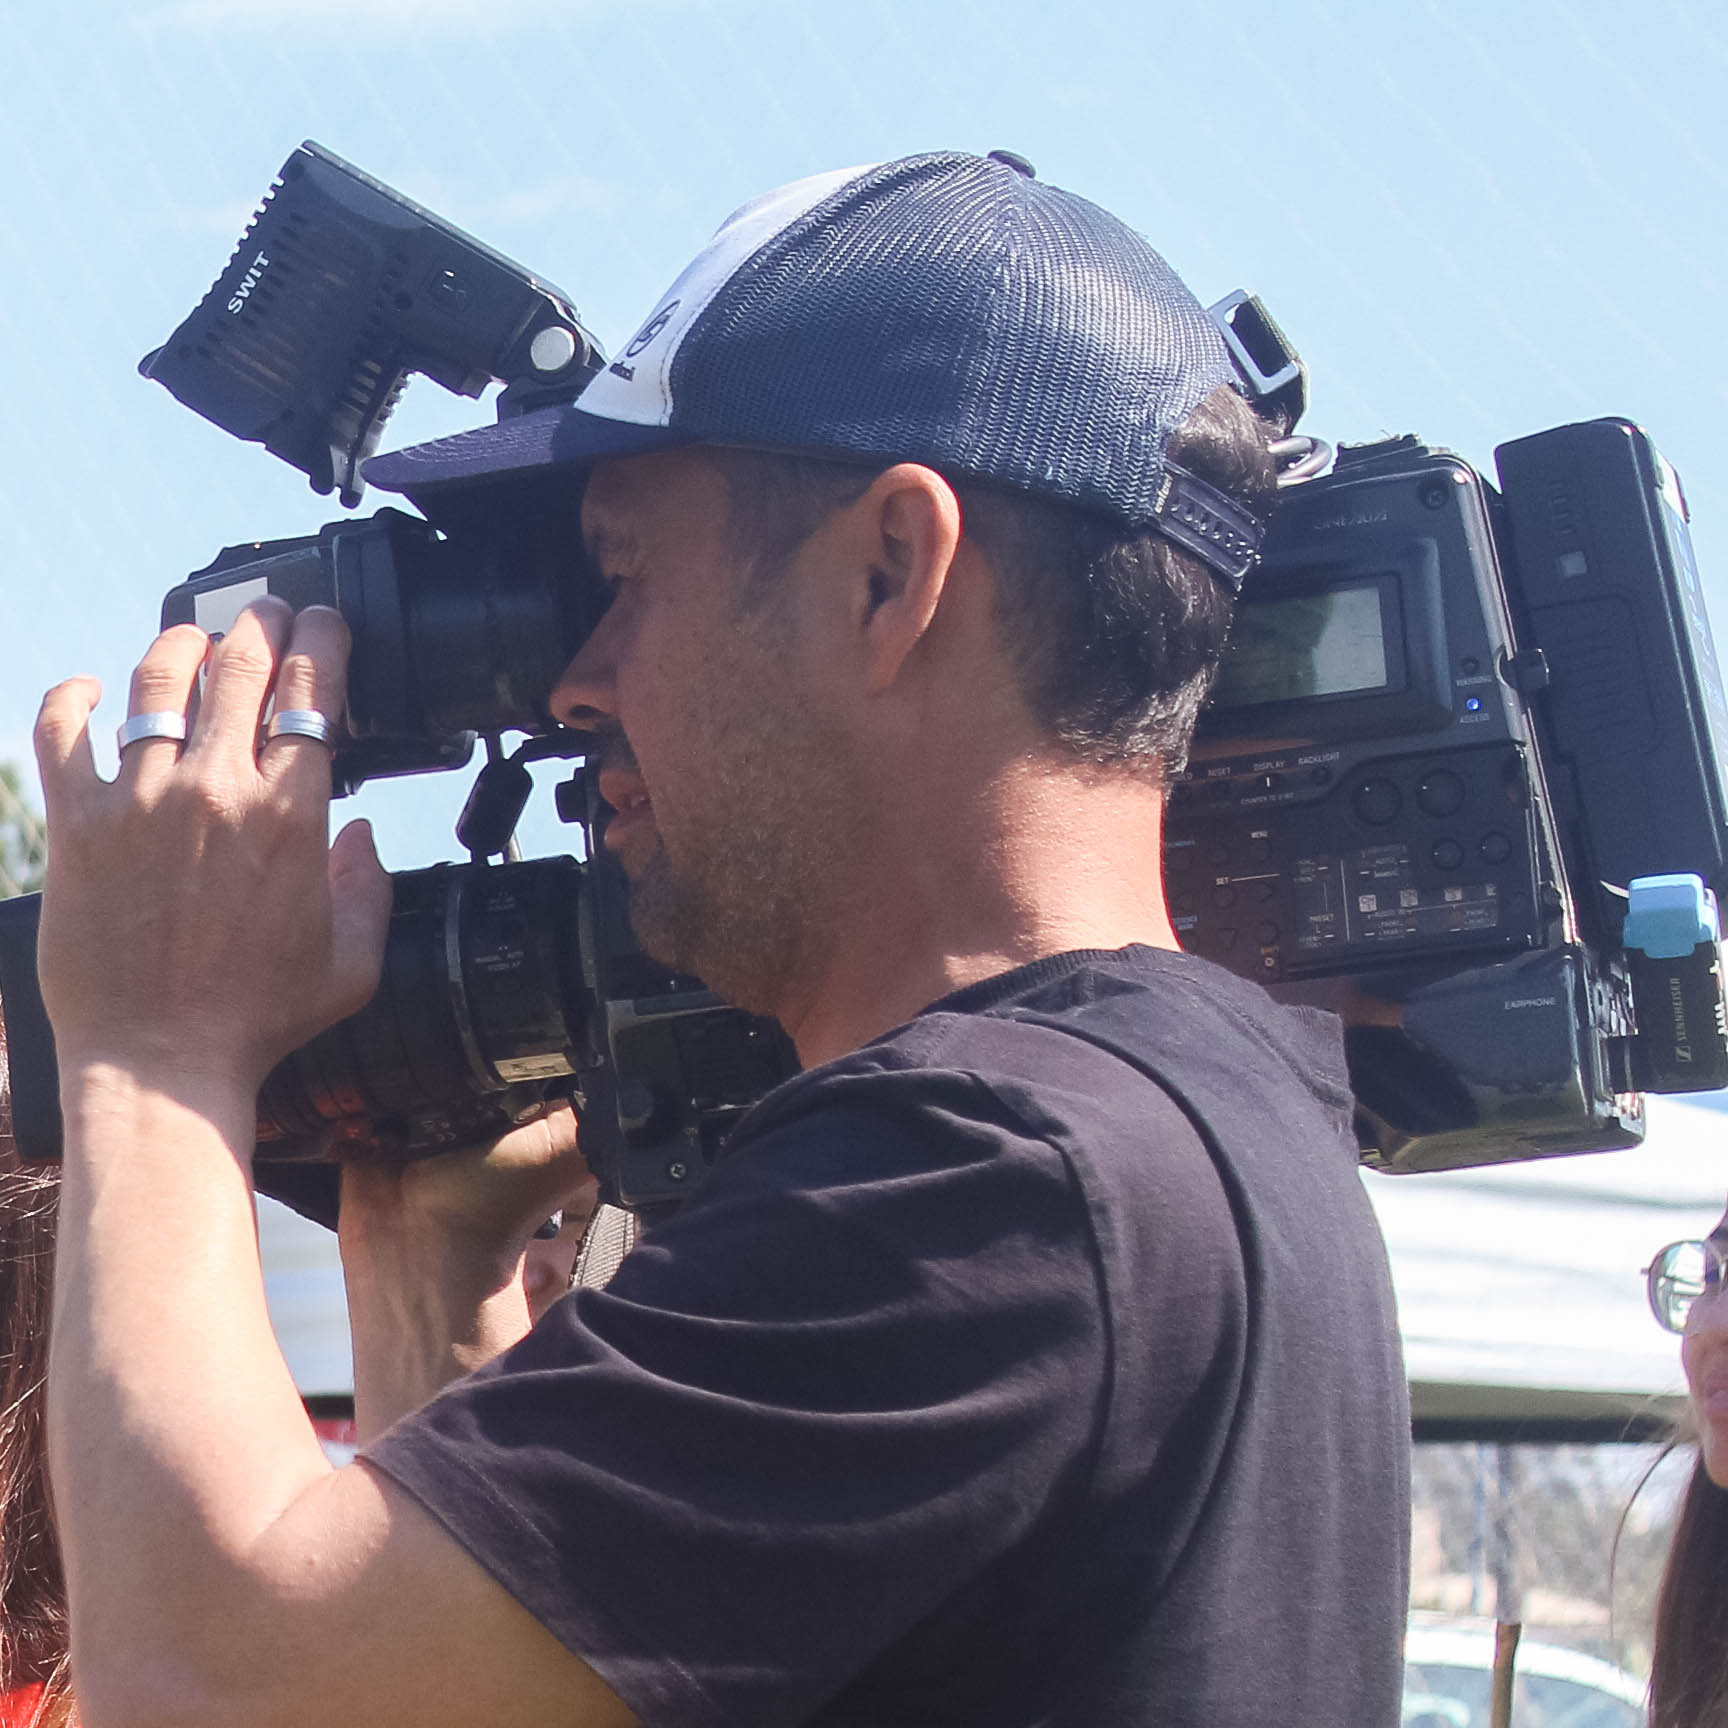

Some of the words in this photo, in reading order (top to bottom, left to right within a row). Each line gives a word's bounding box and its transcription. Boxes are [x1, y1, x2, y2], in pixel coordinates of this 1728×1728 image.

[228, 251, 269, 314] SWIT
[1253, 760, 1286, 771] DISPLAY
[1298, 752, 1340, 765] BACKLIGHT
[1504, 996, 1557, 1010] EARPHONE
[1670, 978, 1687, 1042] SENNHEISER
